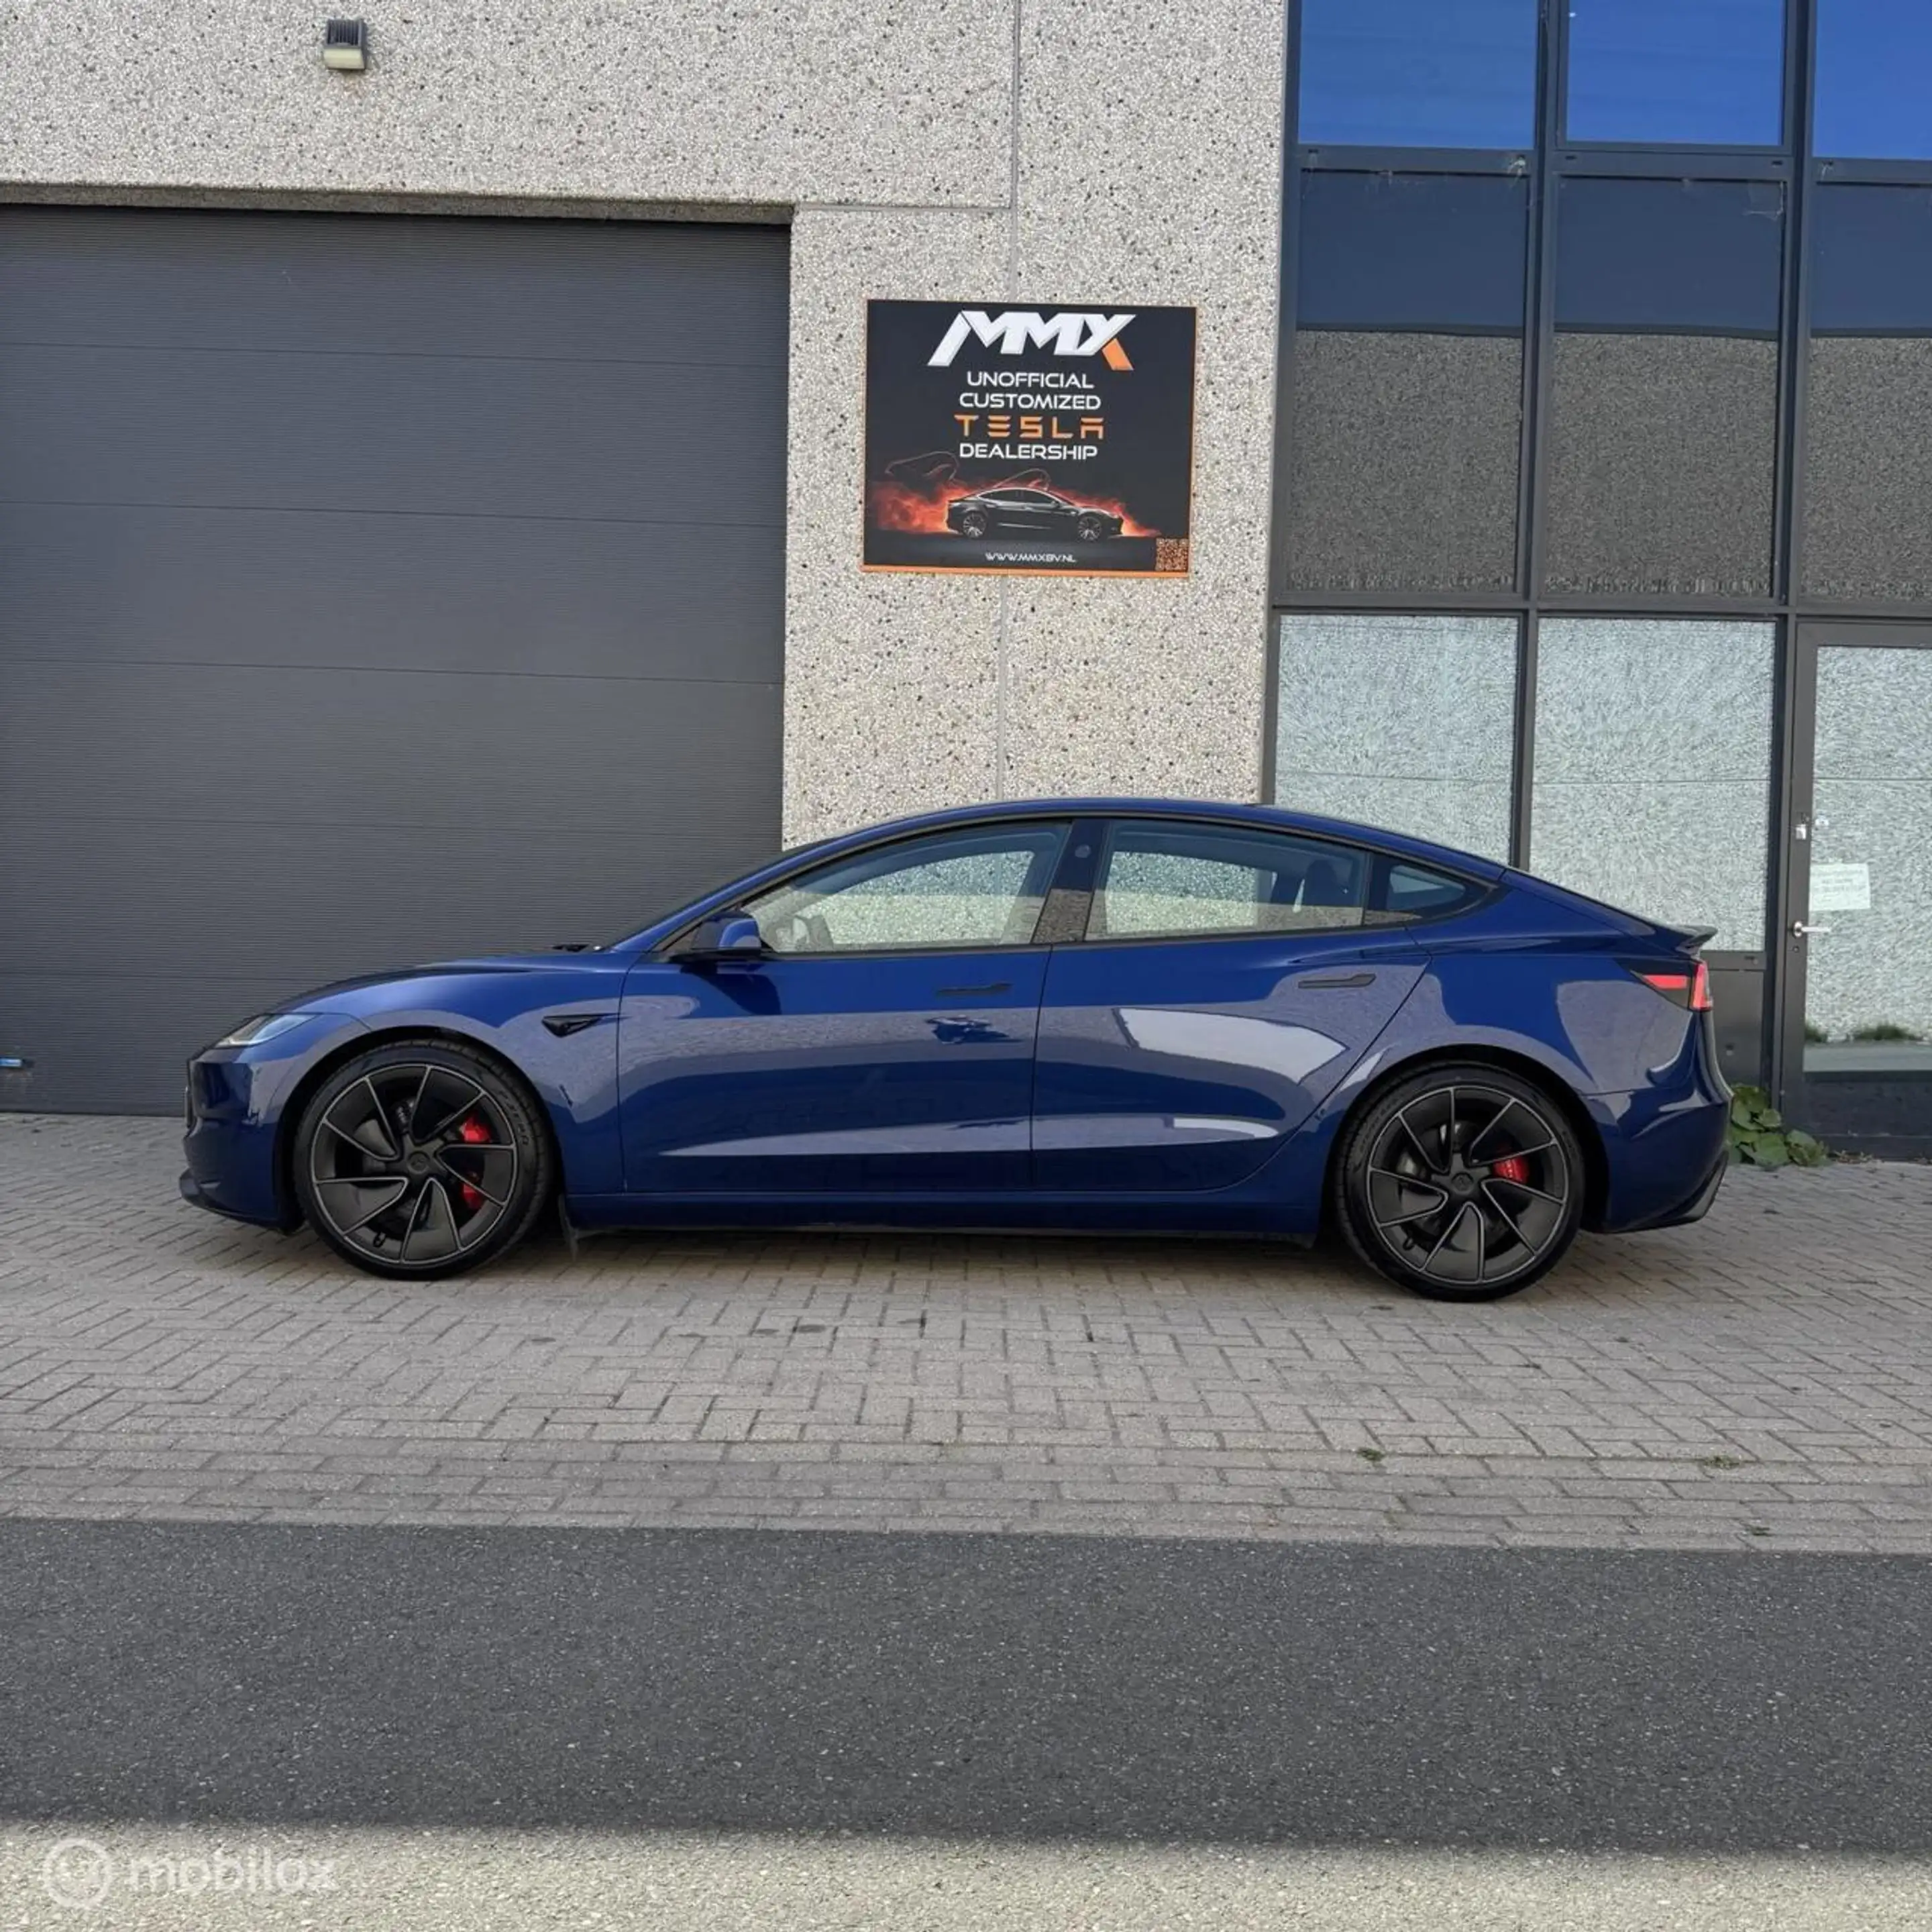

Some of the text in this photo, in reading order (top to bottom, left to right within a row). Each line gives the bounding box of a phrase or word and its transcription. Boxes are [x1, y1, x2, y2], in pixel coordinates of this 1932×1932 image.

[927, 311, 1136, 370] MMX
[967, 371, 1095, 389] UNOFFICIAL
[959, 392, 1102, 411] CUSTOMIZED
[954, 414, 1104, 440] TESLA
[959, 443, 1098, 460] DEALERSHIP
